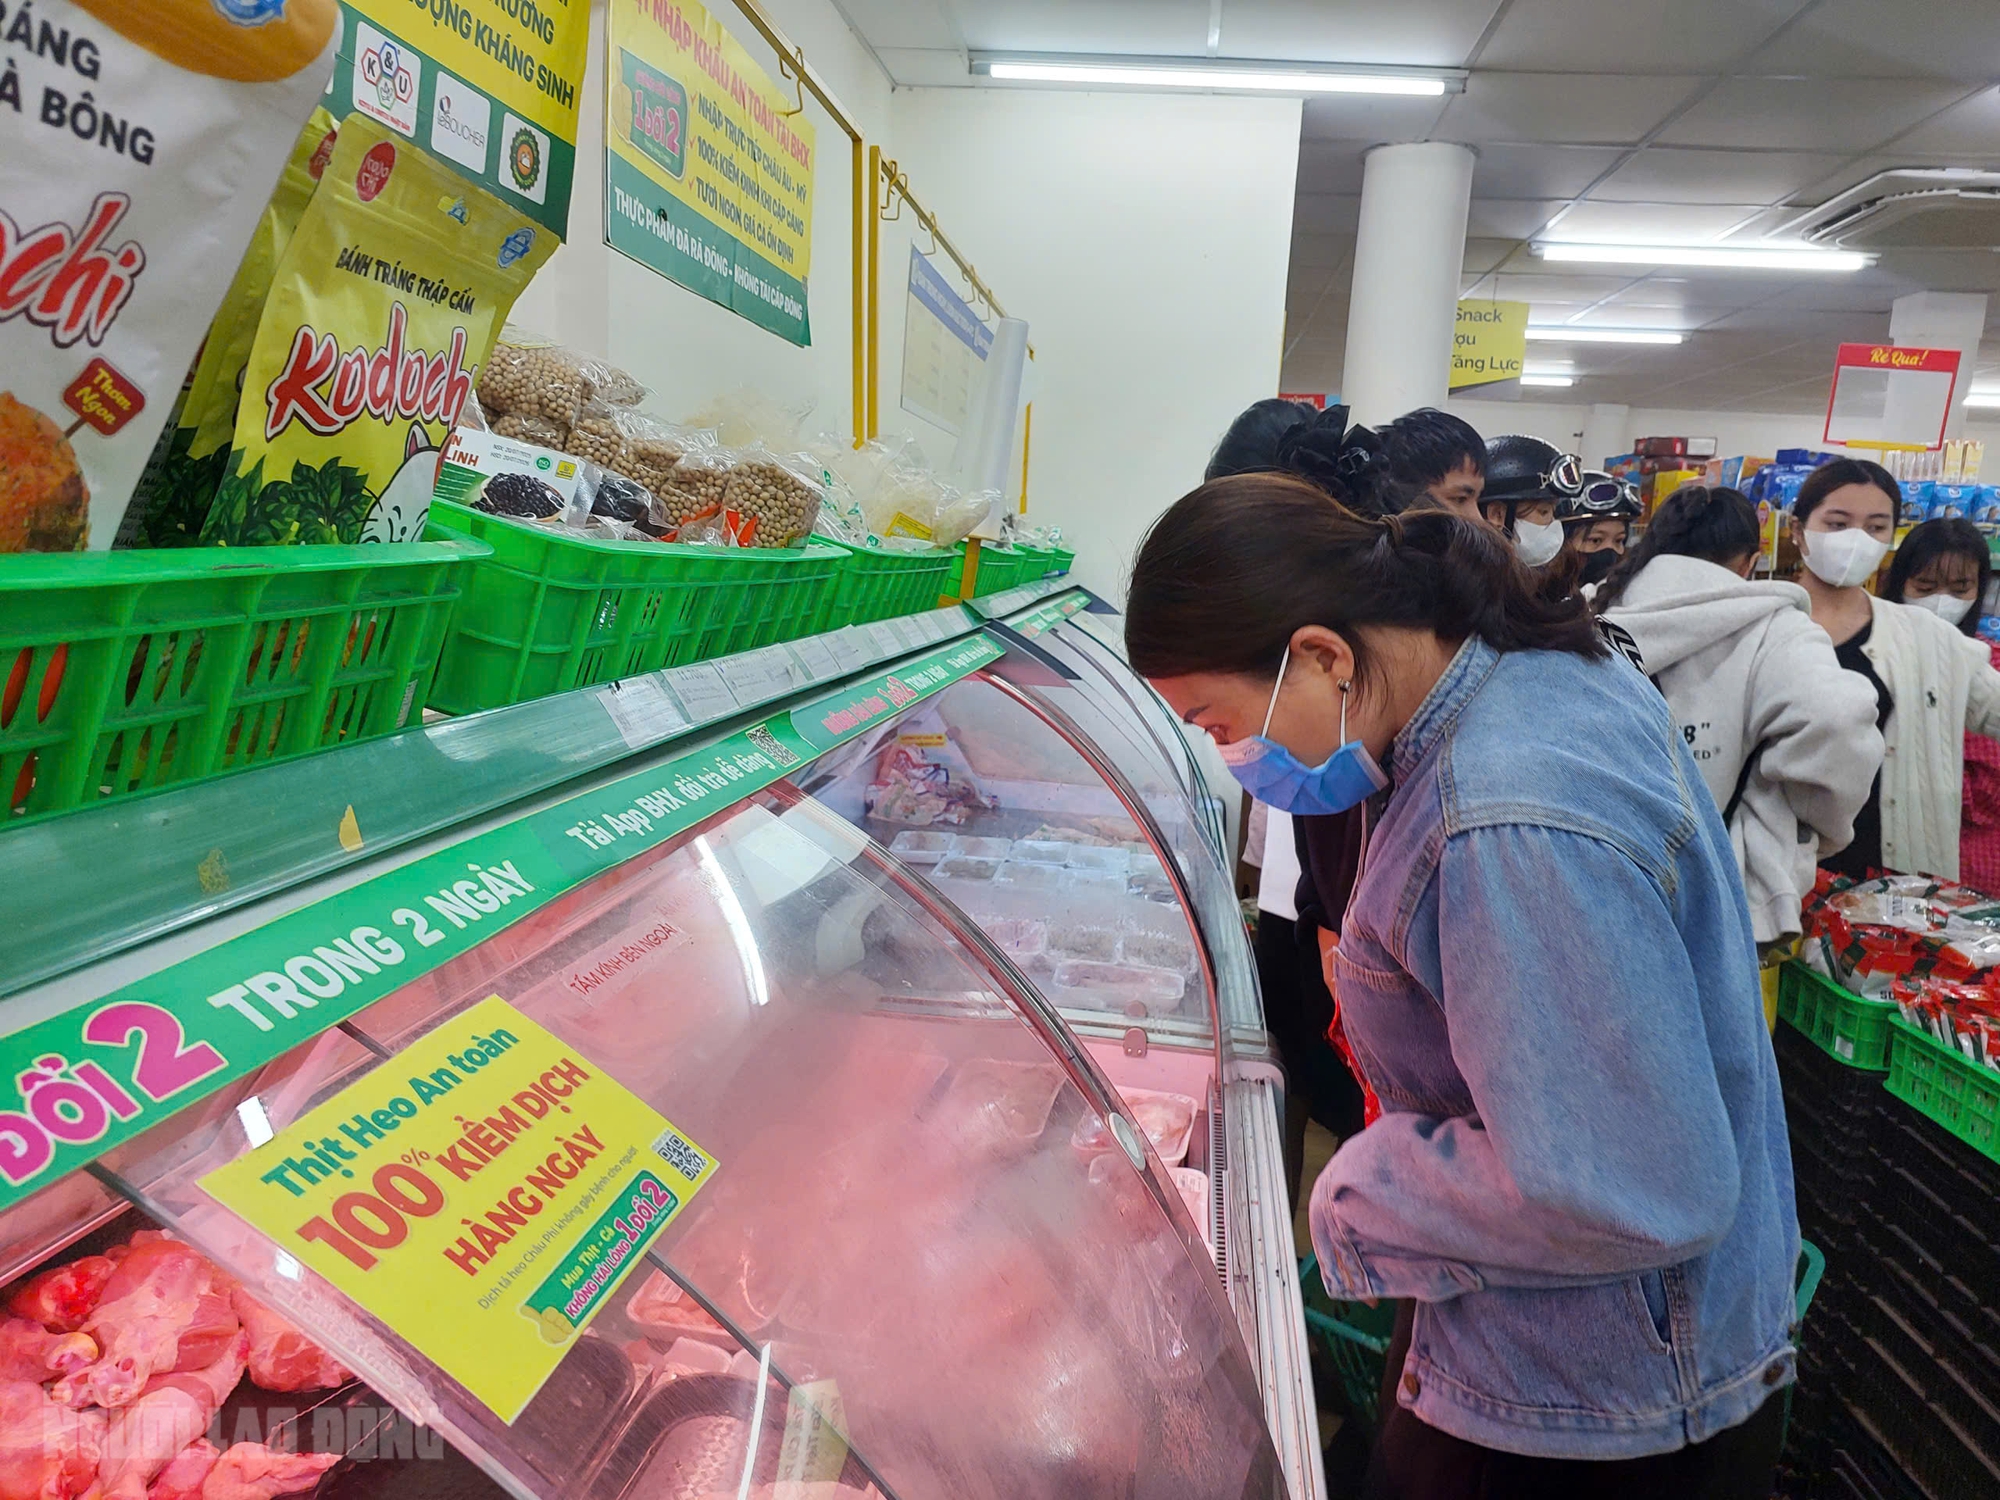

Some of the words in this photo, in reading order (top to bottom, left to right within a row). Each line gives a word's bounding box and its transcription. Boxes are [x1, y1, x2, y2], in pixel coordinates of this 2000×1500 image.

[0, 1, 101, 81] ÁNG
[367, 56, 377, 78] K
[384, 51, 394, 71] &
[399, 74, 408, 94] U
[474, 19, 535, 83] KHÁNG
[536, 63, 574, 110] SINH
[40, 86, 156, 166] BÔNG
[634, 89, 645, 132] 1
[665, 106, 681, 158] 2
[724, 115, 746, 152] TRỰC
[731, 73, 747, 110] AN
[749, 89, 775, 138] TOÀN
[775, 113, 791, 155] TẠI
[790, 132, 810, 171] BHX
[697, 135, 719, 171] 100%
[719, 152, 740, 188] KIỂM
[740, 169, 760, 203] ĐỊNH
[760, 188, 773, 214] KHI
[614, 186, 645, 228] THỰC
[703, 244, 729, 278] ĐÔNG
[784, 296, 803, 321] ĐÔNG
[696, 176, 718, 212] TƯƠI
[743, 212, 757, 240] GIÁ
[777, 237, 795, 266] ĐỊNH
[335, 244, 374, 277] BÁNH
[374, 260, 417, 294] TRÁNG
[416, 278, 450, 308] THẬP
[1454, 332, 1476, 348] ợu
[1456, 307, 1502, 322] Snack
[1489, 355, 1520, 374] Lực
[75, 386, 117, 425] Ngon
[82, 1000, 230, 1103] 2
[207, 926, 407, 1032] TRONG
[391, 907, 444, 948] 2
[423, 860, 536, 930] NGÀY
[565, 819, 616, 850] Tải
[602, 808, 654, 837] App
[634, 786, 687, 819] BHX
[674, 773, 710, 802] đổi
[697, 766, 730, 789] trả
[714, 756, 745, 781] dễ
[732, 751, 776, 771] dàng
[570, 971, 605, 995] TẤM
[619, 941, 647, 963] BÊN
[638, 922, 678, 950] NGOÀI
[260, 1136, 358, 1197] Thịt
[337, 1096, 418, 1150] Heo
[408, 1066, 463, 1106] An
[447, 1027, 521, 1074] toàn
[295, 1147, 445, 1272] 100%
[435, 1105, 533, 1182] KIỂM
[511, 1058, 591, 1120] DỊCH
[639, 1178, 671, 1208] 2
[442, 1186, 544, 1277] HÀNG
[525, 1124, 606, 1199] NGÀY
[477, 1284, 502, 1310] Dịch
[507, 1261, 527, 1283] heo
[522, 1241, 547, 1263] Châu
[541, 1223, 560, 1244] Phi
[554, 1204, 584, 1230] không
[580, 1191, 596, 1211] gây
[589, 1174, 610, 1196] bệnh
[607, 1162, 622, 1180] cho
[619, 1145, 639, 1167] người
[614, 1217, 639, 1244] 1
[628, 1195, 658, 1232] ĐỔI
[561, 1264, 585, 1290] Mua
[578, 1243, 601, 1267] Thịt
[600, 1224, 616, 1243] Cá
[592, 1262, 612, 1286] HÀI
[608, 1239, 633, 1270] LÒNG
[565, 1279, 599, 1319] KHÔNG
